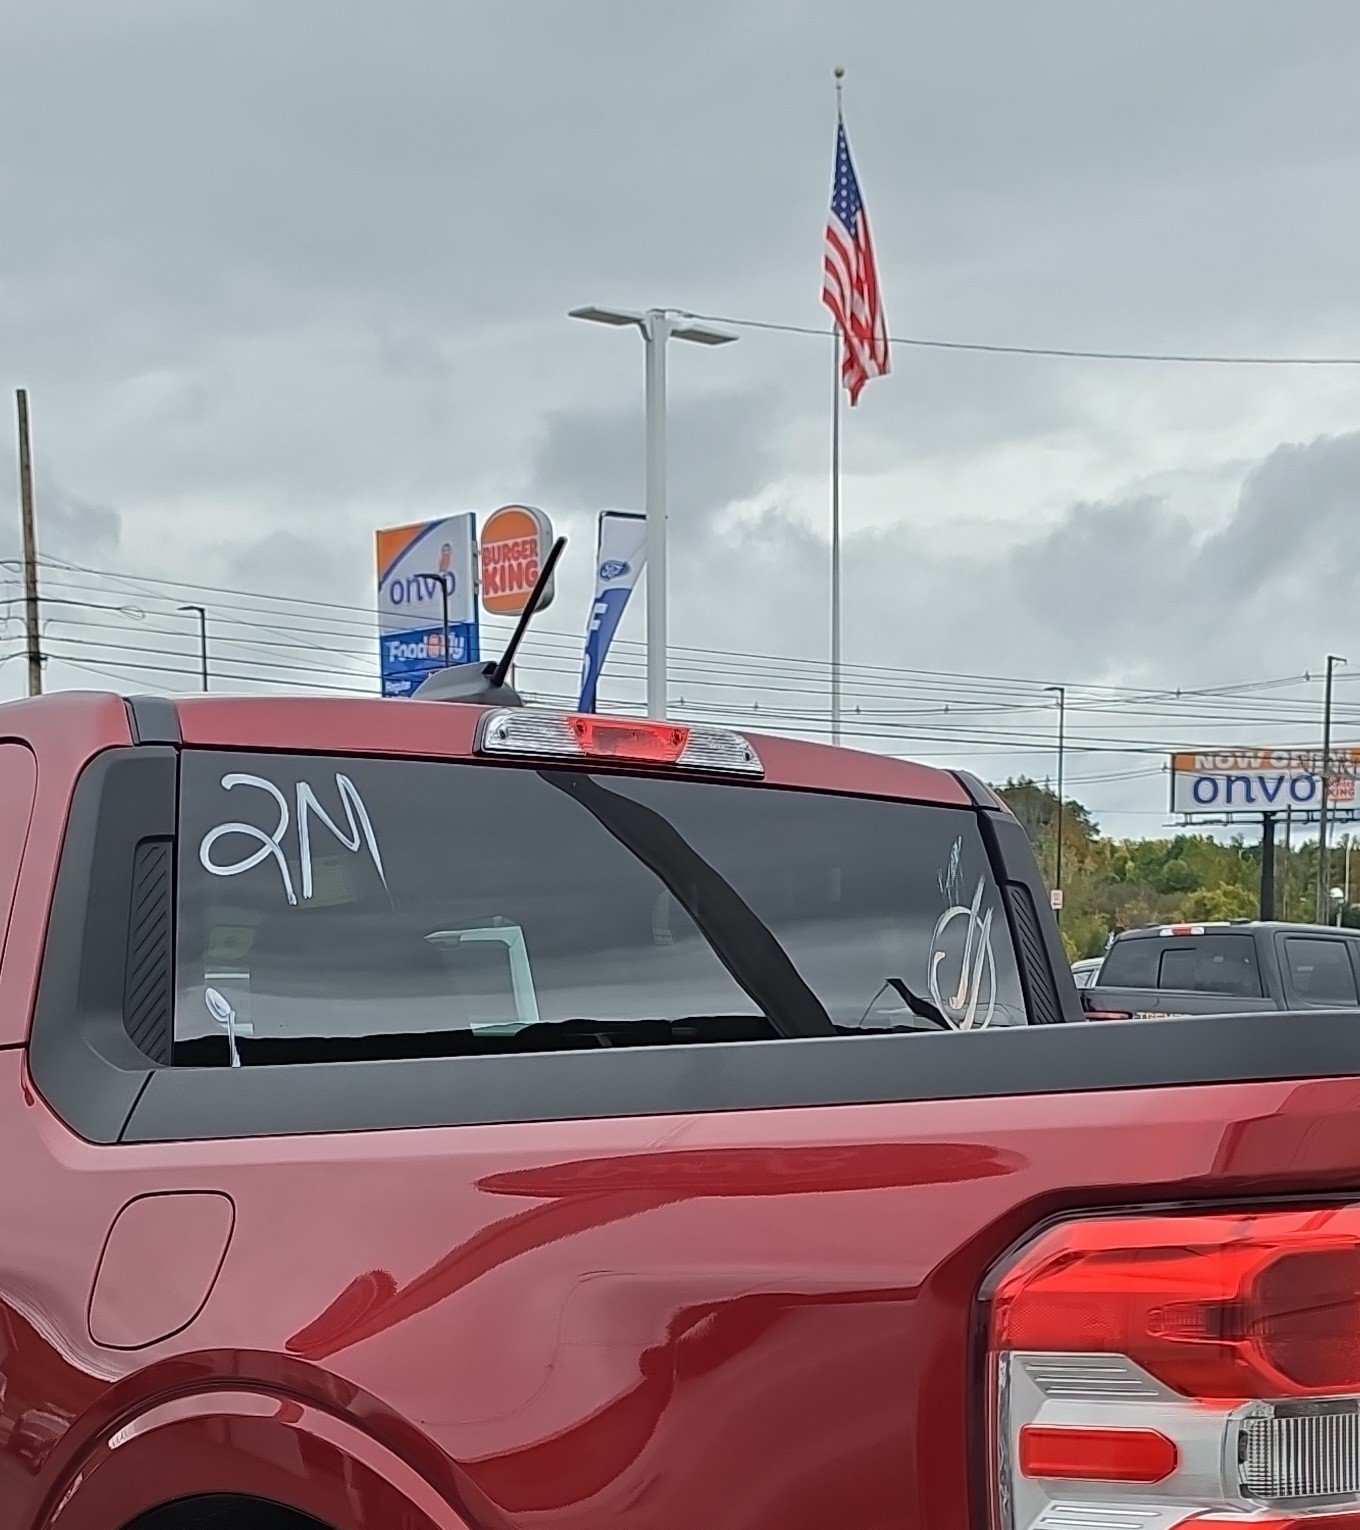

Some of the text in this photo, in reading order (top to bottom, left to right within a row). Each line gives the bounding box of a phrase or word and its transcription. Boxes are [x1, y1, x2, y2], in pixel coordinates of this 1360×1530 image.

[483, 537, 539, 567] BURGER
[391, 570, 456, 604] onvo
[483, 559, 539, 593] KING
[1194, 751, 1264, 769] NOW
[1192, 774, 1317, 804] onvo
